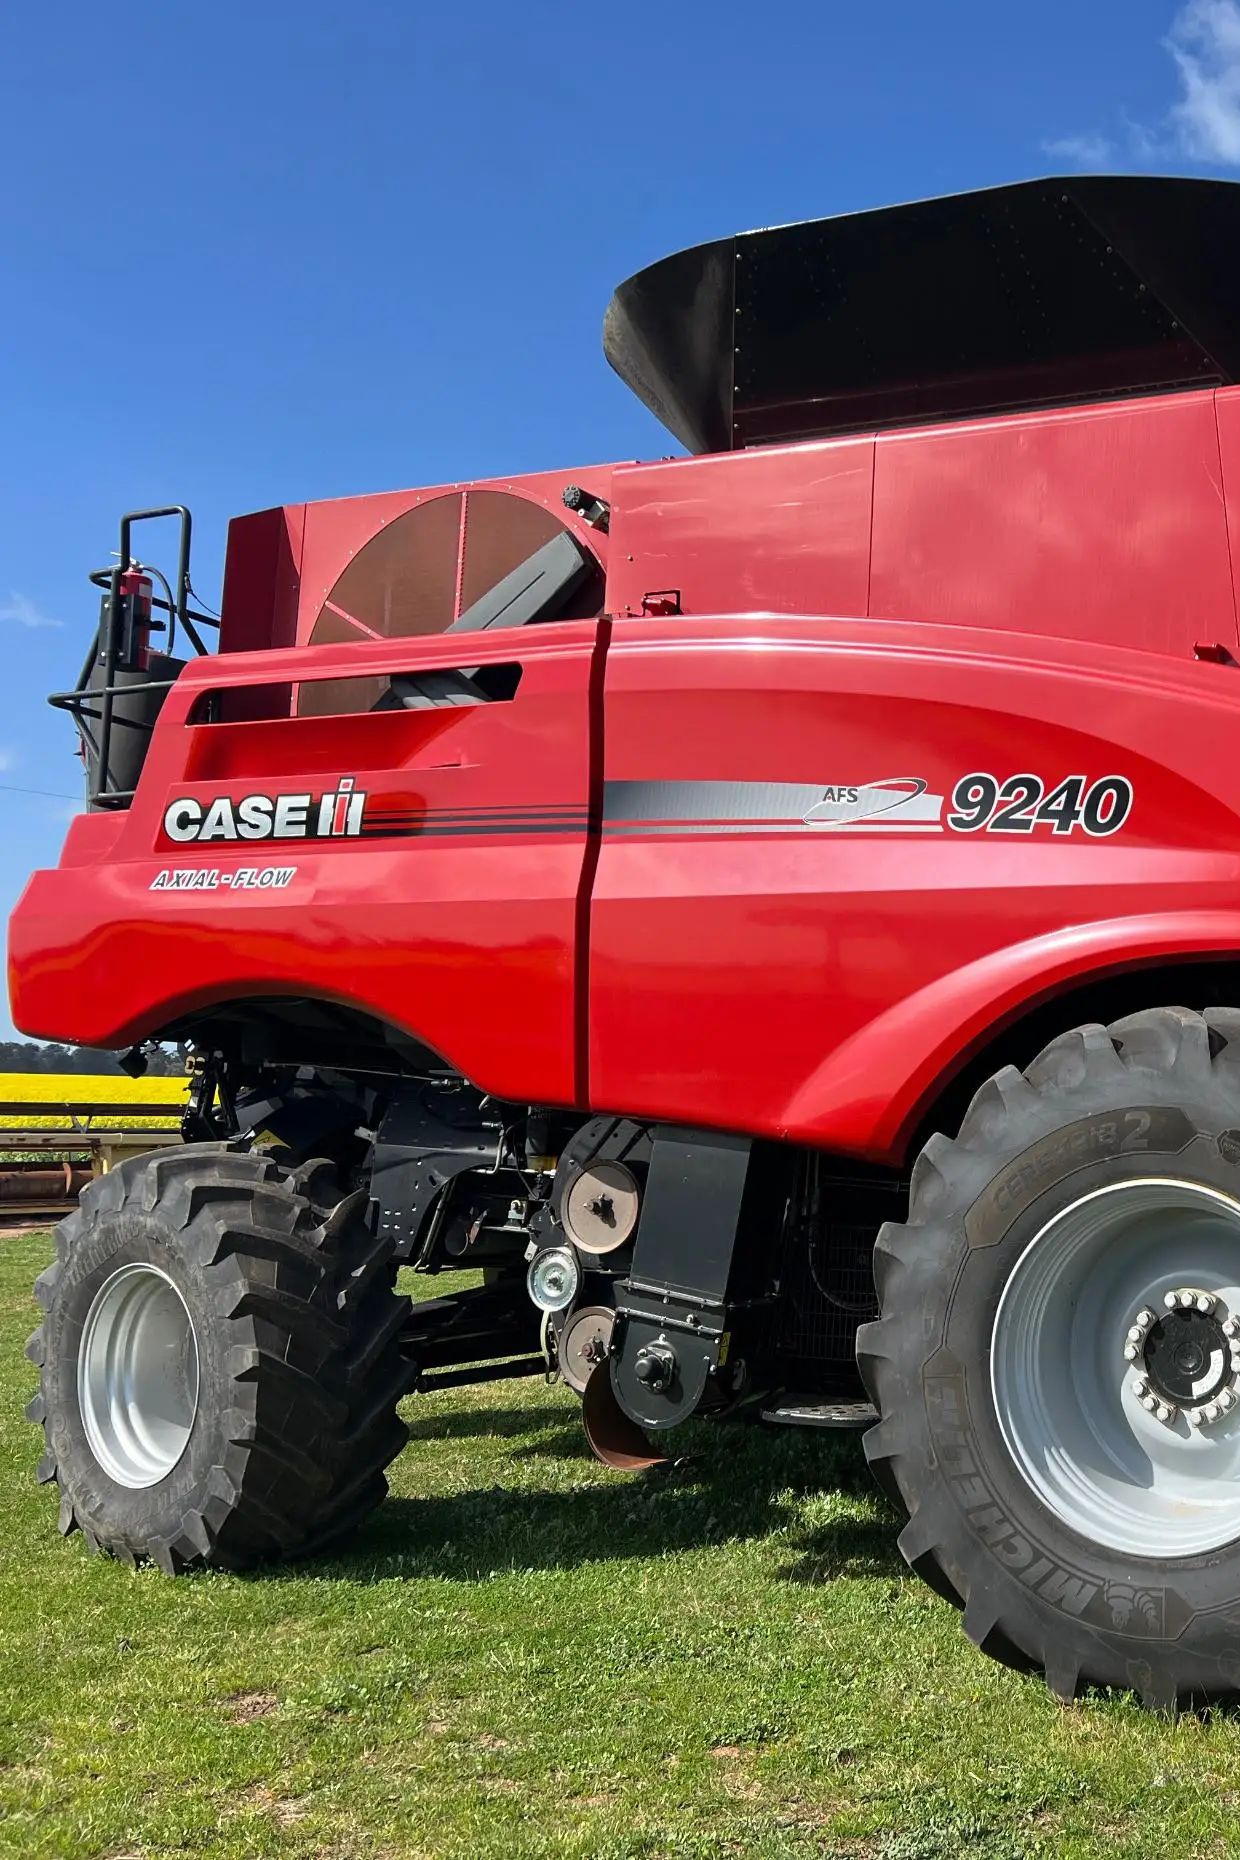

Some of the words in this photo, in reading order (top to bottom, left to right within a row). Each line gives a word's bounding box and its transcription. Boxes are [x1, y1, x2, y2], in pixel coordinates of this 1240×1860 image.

[822, 787, 858, 803] AFS
[948, 772, 1133, 837] 9240
[164, 794, 312, 842] CASE
[149, 866, 297, 890] AXIAL-FLOW
[1121, 1111, 1151, 1149] 2
[925, 1382, 1099, 1616] MICHELIN
